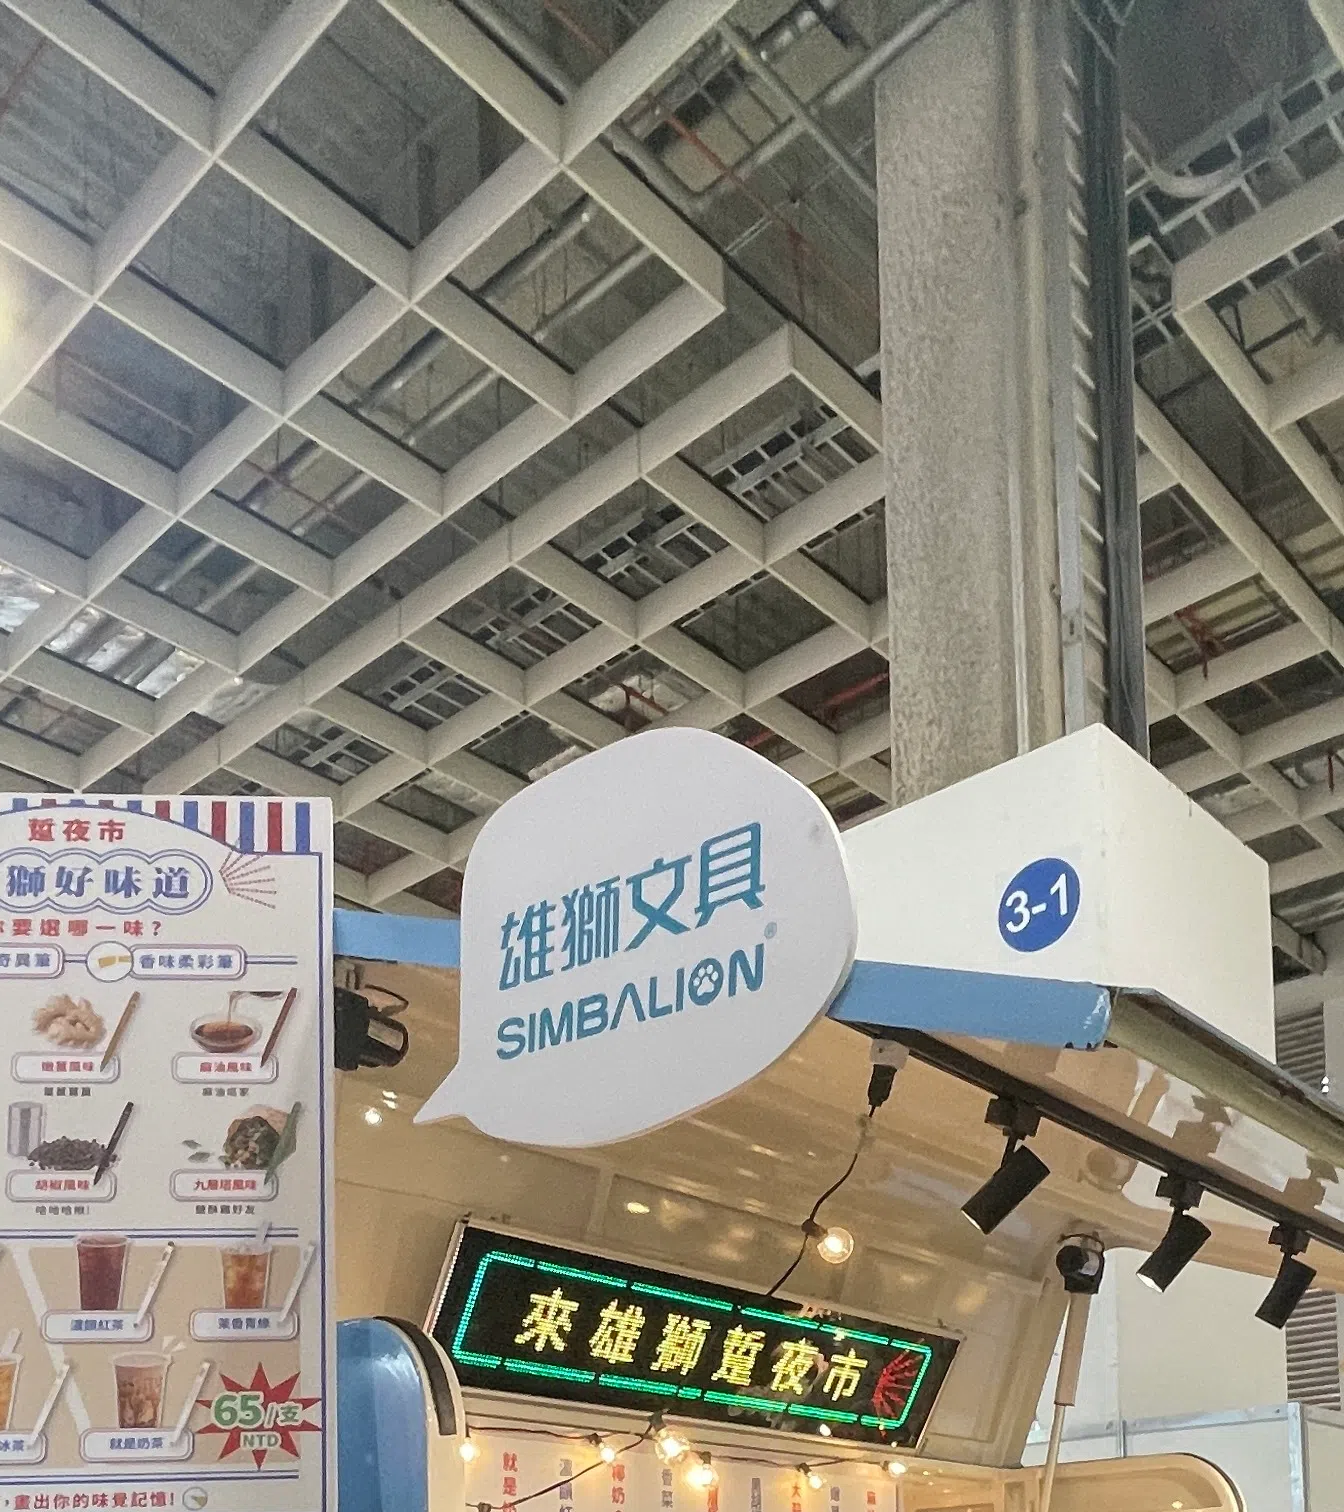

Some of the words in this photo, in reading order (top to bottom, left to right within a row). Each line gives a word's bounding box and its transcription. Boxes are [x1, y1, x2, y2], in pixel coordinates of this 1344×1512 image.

[498, 821, 766, 991] 雄獅文具
[1006, 873, 1068, 933] 3-1
[497, 944, 765, 1060] SIMBALION
[242, 1433, 279, 1448] NTD
